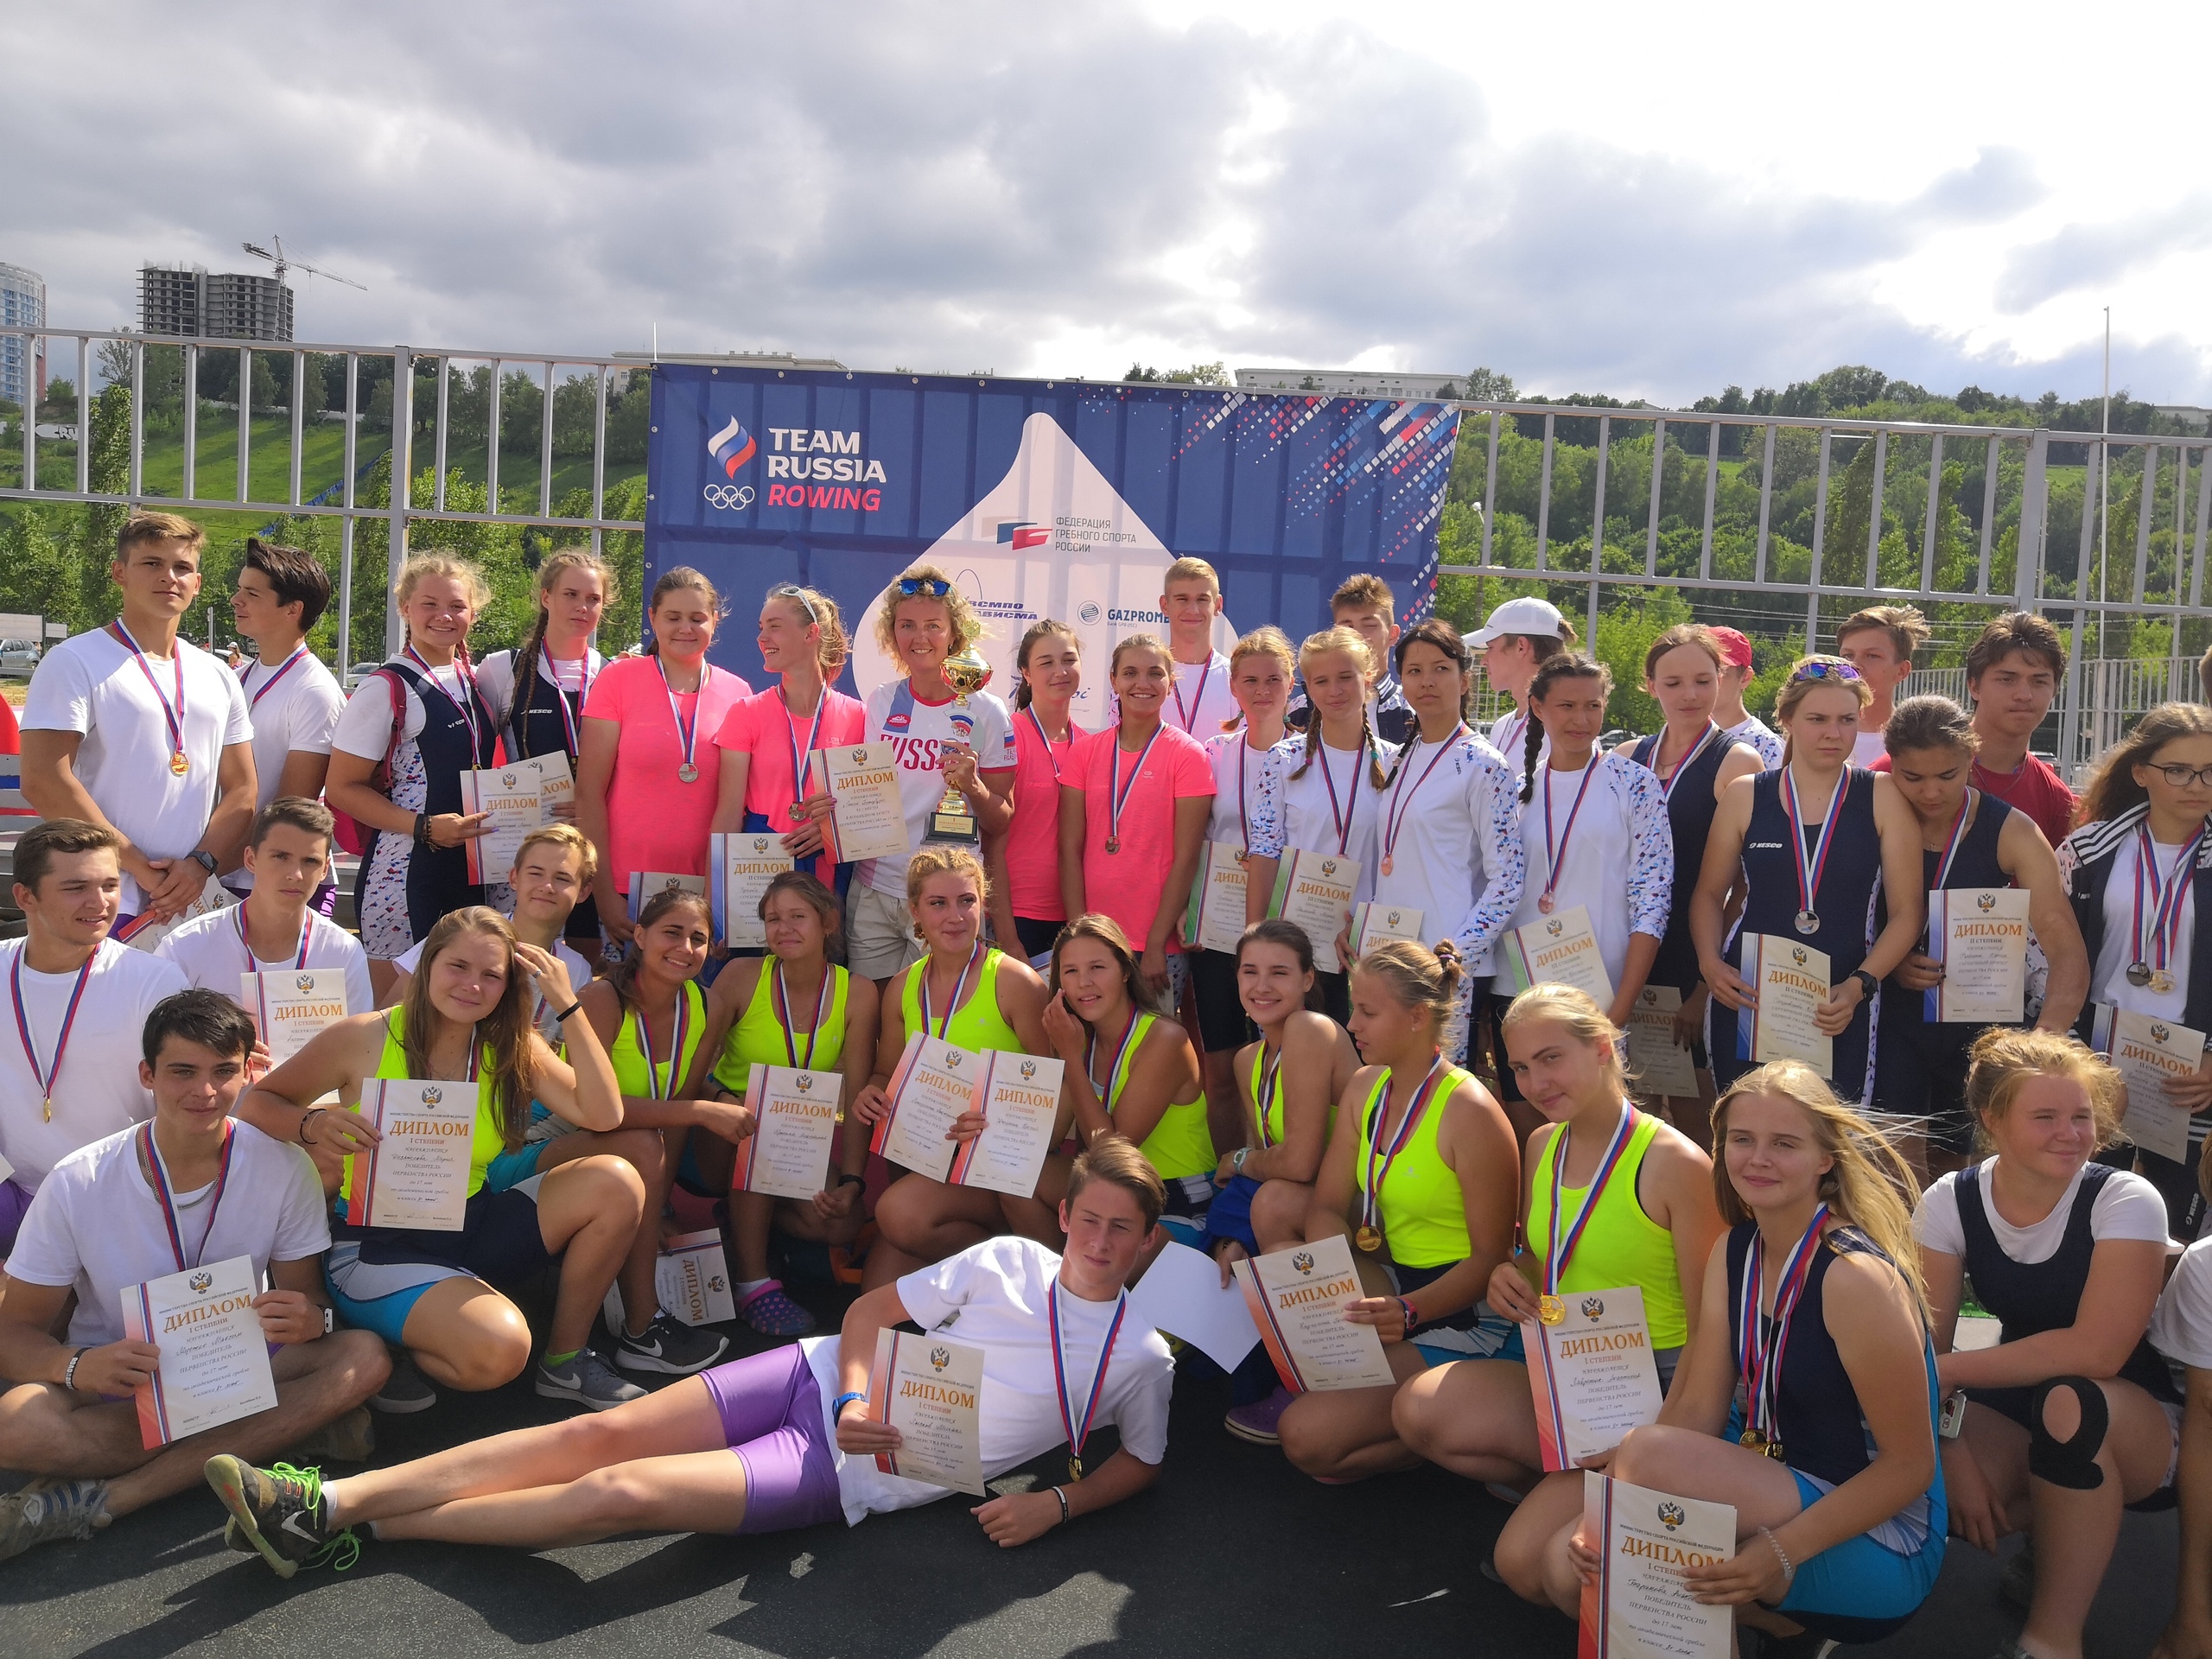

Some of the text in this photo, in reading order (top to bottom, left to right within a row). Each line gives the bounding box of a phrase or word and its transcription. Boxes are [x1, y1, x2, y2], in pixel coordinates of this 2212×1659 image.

[768, 428, 861, 454] TEAM
[767, 455, 887, 483] RUSSIA
[768, 485, 881, 512] ROWING
[1057, 517, 1110, 529] ФЕДЕРАЦИЯ
[1056, 530, 1136, 543] ГРЕБНОГО СПОРТА
[1056, 542, 1090, 552] РОССИИ
[969, 601, 1023, 609] ВСМПО
[836, 771, 893, 790] ДИПЛОМ
[486, 798, 537, 811] ДИПЛОМ
[734, 863, 791, 875] ДИПЛОМ
[1214, 872, 1246, 885] ДИПЛ
[1297, 882, 1351, 901] ДИПЛОМ
[1955, 925, 2022, 938] ДИПЛОМ
[1536, 938, 1593, 968] ДИПЛОМ
[1768, 970, 1827, 998] ДИПЛОМ
[274, 1004, 342, 1021] ДИПЛОМ
[2121, 1044, 2193, 1076] ДИПЛОМ
[915, 1070, 972, 1100] ДИПЛОМ
[995, 1088, 1054, 1109] ДИПЛОМ
[769, 1100, 832, 1119] ДИПЛОМ
[390, 1120, 469, 1136] ДИПЛОМ
[1279, 1278, 1357, 1310] ДИПЛОМ
[163, 1294, 252, 1334] ДИПЛОМ
[194, 1318, 228, 1332] СТЕПЕНИ
[1560, 1332, 1645, 1359] ДИПЛОМ
[180, 1349, 247, 1374] ПЕРВЕНСТВА РОССИИ
[900, 1380, 975, 1408] ДИПЛОМ
[923, 1403, 952, 1414] СТЕПЕНИ
[1619, 1523, 1653, 1536] МИНИСТЕРСТВО
[1669, 1536, 1698, 1547] РОССИЙСКОЙ
[1697, 1543, 1724, 1552] ФЕДЕРАЦИИ
[1620, 1535, 1725, 1567] ДИПЛОМ
[1654, 1565, 1684, 1577] СТЕПЕ
[1644, 1594, 1692, 1611] ПОБЕДИТЕЛЬ
[1629, 1601, 1707, 1625] ПЕРВЕНСТВА РОССИИ
[1637, 1625, 1684, 1643] академической
[1685, 1637, 1706, 1648] гребле
